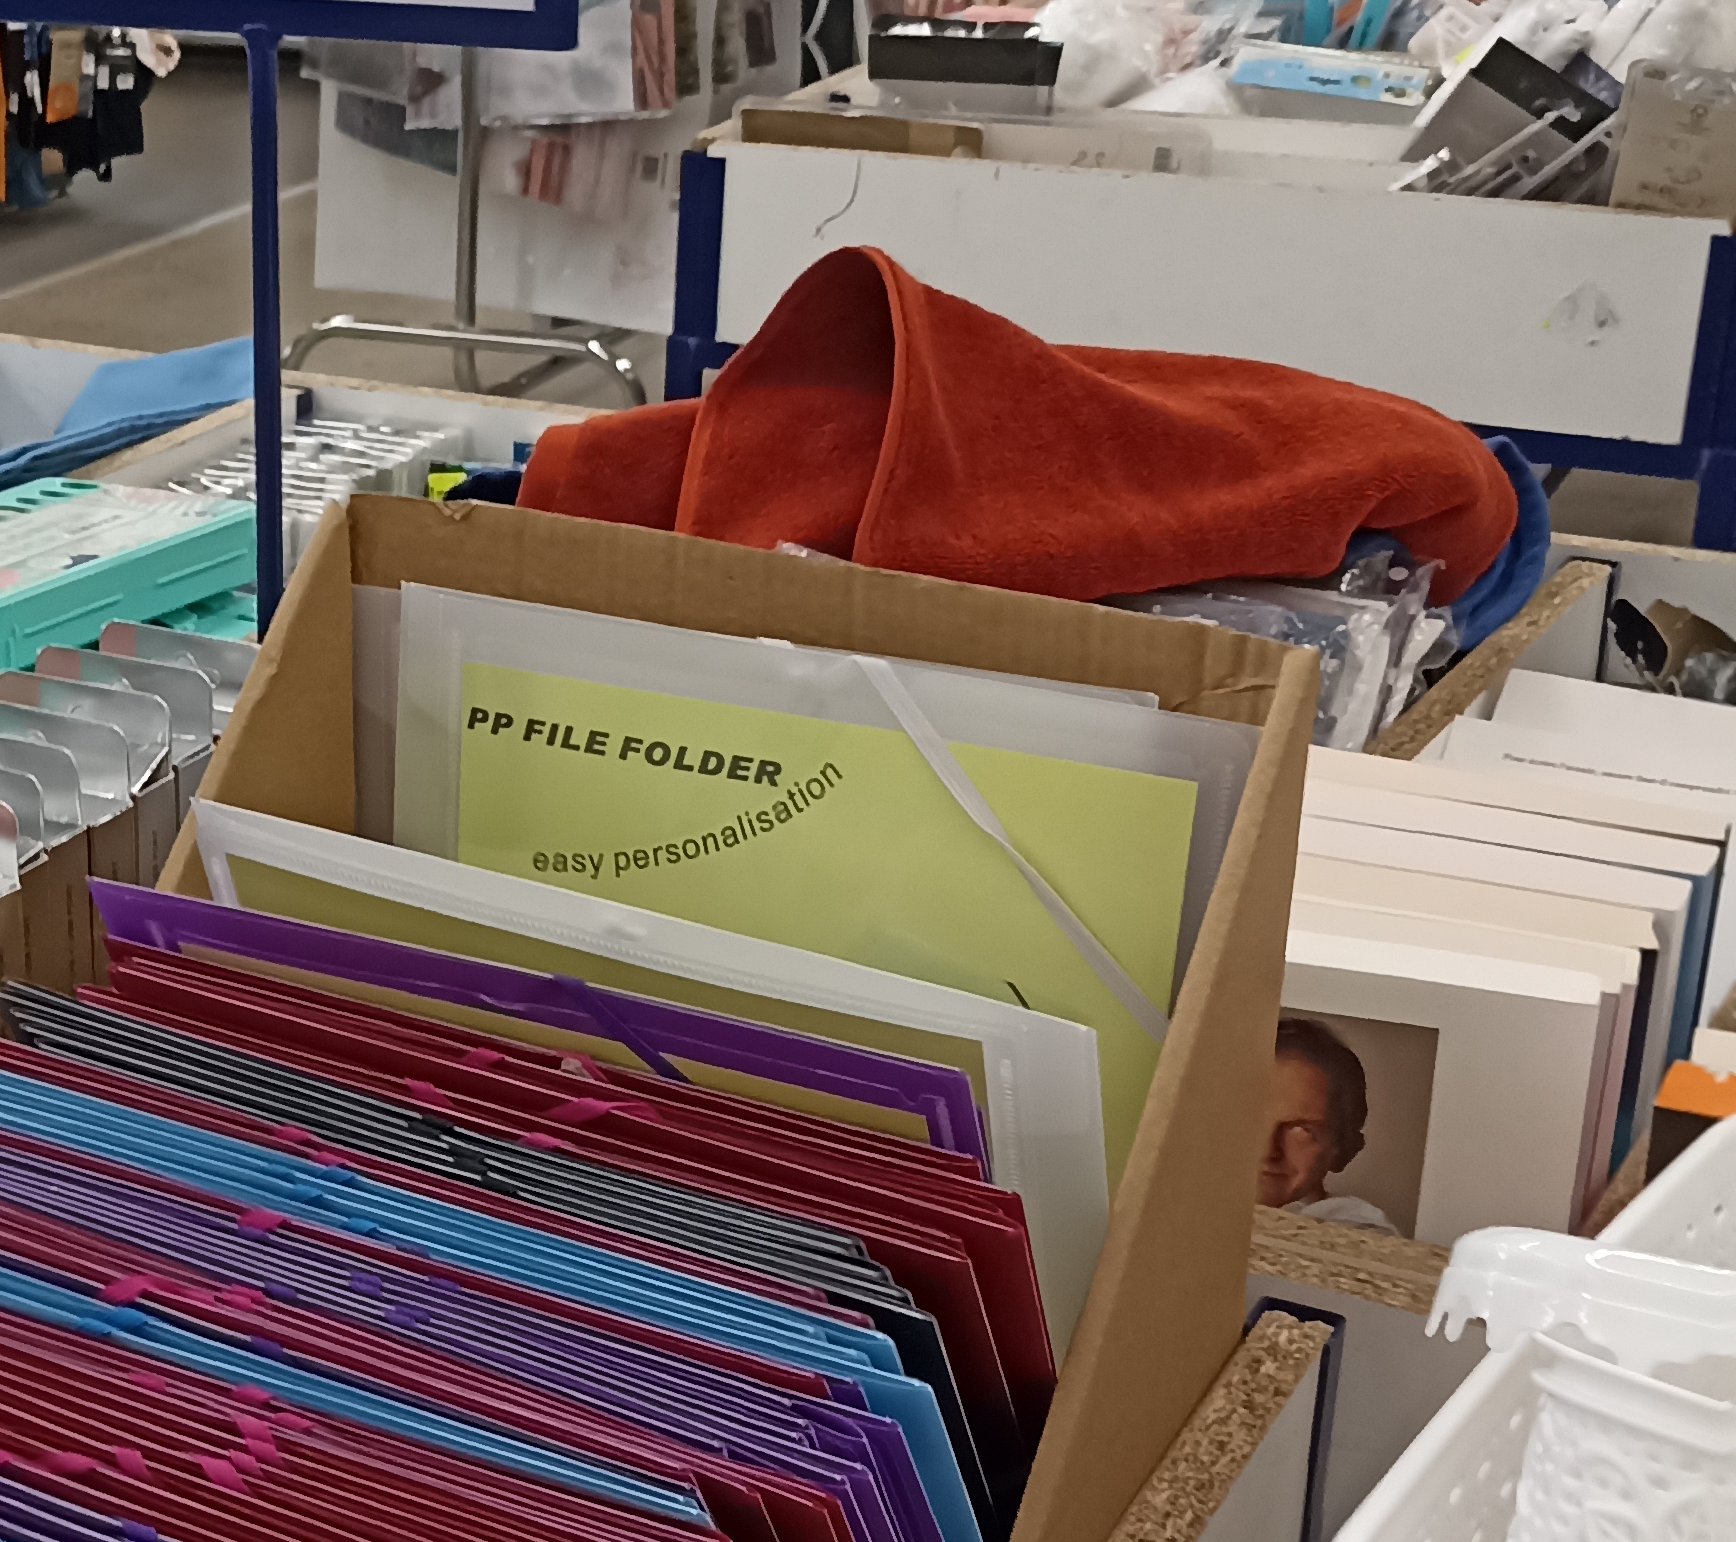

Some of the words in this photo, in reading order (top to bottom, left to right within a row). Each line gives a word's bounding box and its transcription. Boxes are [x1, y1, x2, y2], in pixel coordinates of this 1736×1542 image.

[466, 707, 515, 736] PP
[522, 718, 610, 757] FILE
[618, 736, 784, 788] FOLDER
[531, 849, 606, 881] easy
[614, 759, 844, 879] personalisation
